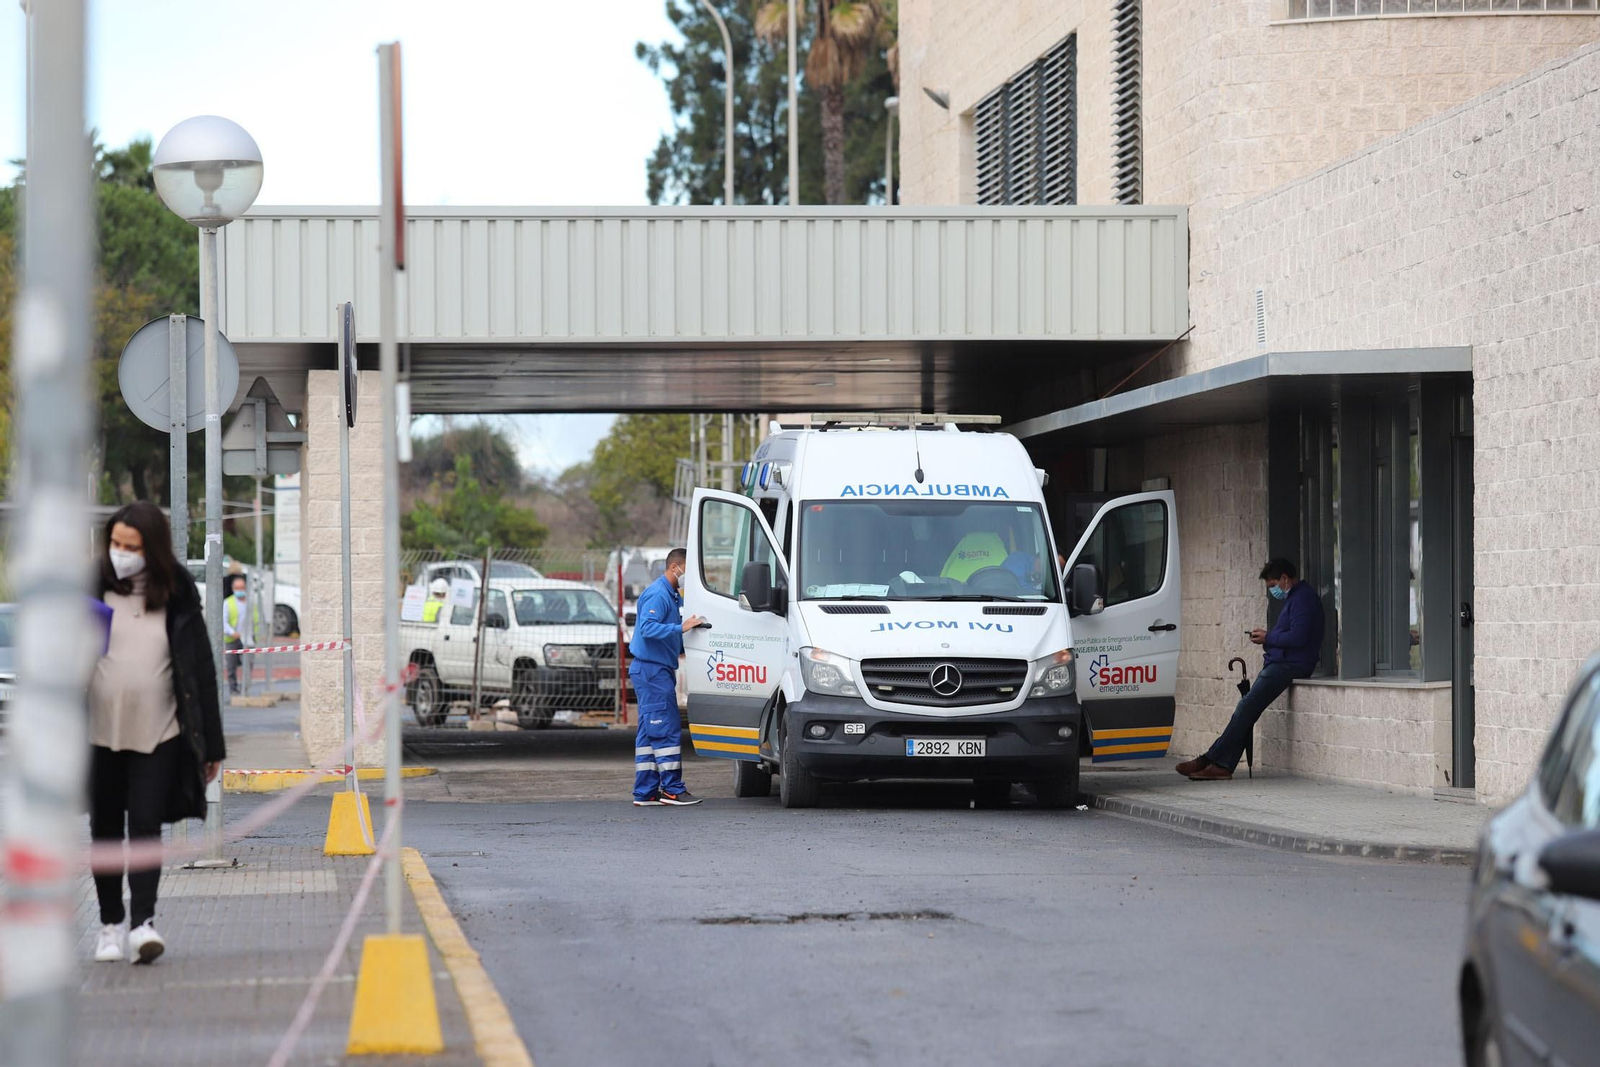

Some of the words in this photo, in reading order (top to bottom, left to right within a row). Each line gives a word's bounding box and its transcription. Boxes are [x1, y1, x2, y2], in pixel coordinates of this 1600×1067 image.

[966, 550, 990, 558] samu
[740, 642, 755, 650] SALUD
[716, 663, 767, 684] samu
[1099, 665, 1157, 685] samu
[716, 681, 752, 691] emergencias
[1099, 684, 1140, 694] emergencias
[846, 724, 864, 733] SP
[917, 741, 950, 755] 2892
[957, 741, 982, 755] KBN
